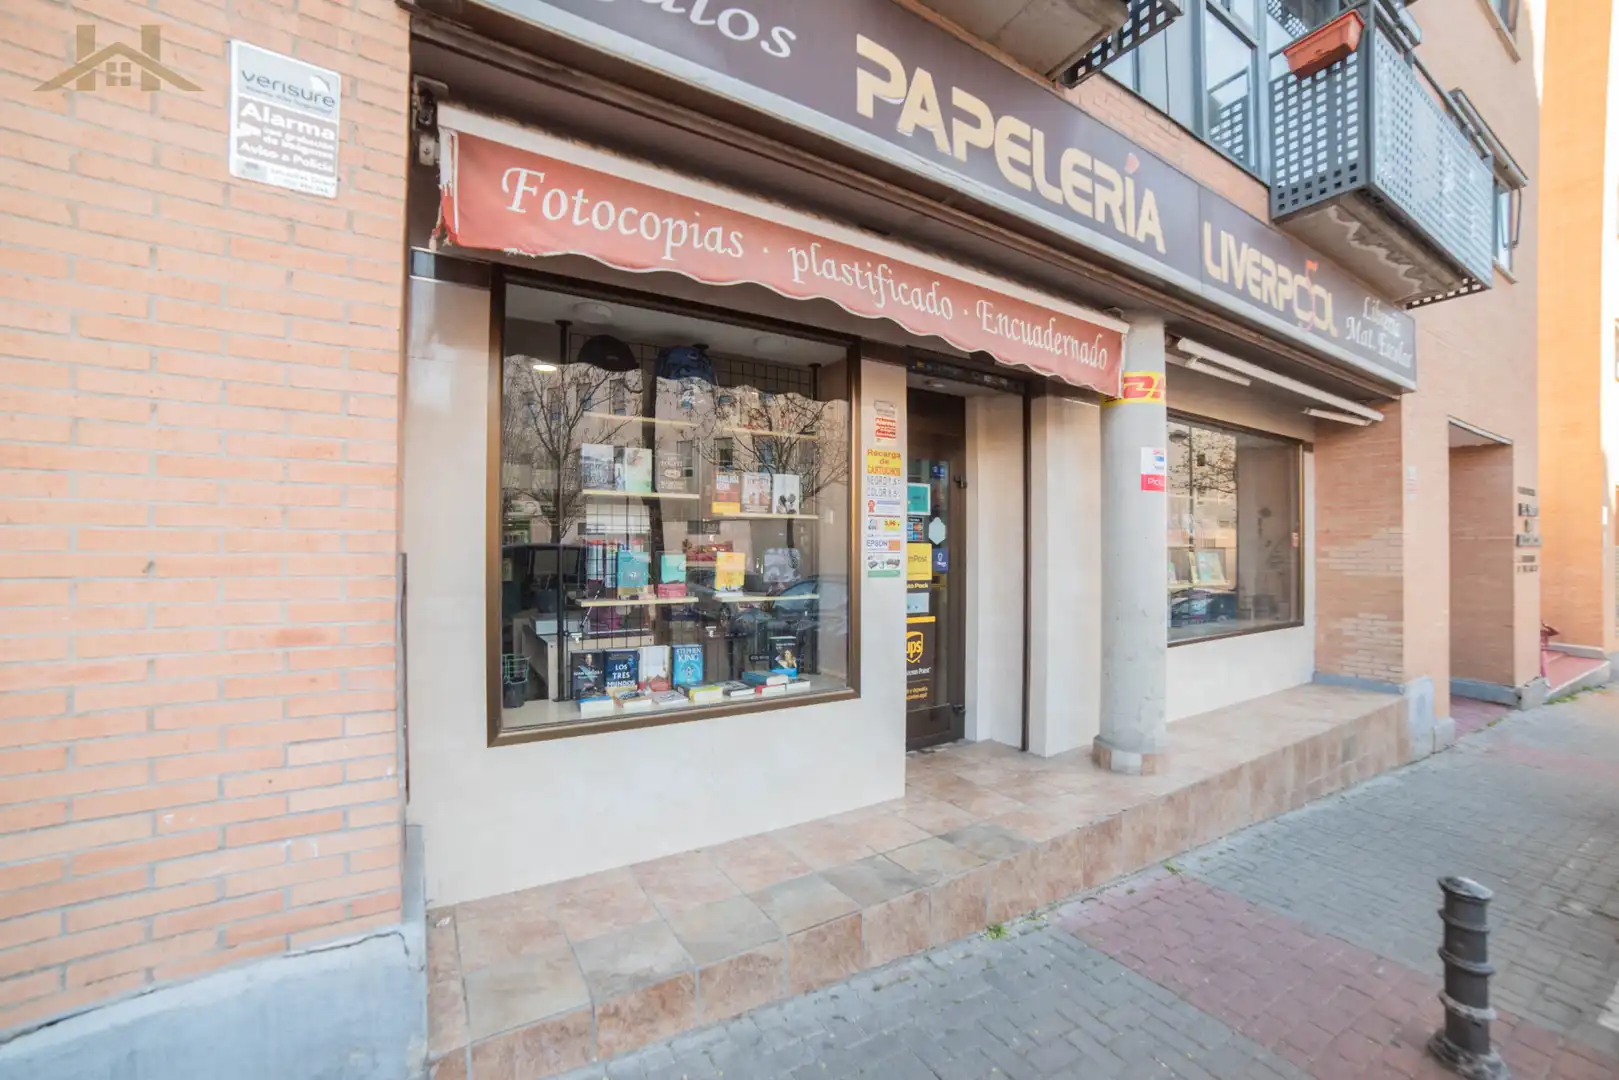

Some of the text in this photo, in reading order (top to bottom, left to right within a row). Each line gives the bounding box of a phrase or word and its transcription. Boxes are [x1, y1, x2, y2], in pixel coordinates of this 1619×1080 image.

[241, 70, 335, 108] verisure
[240, 102, 335, 140] Alarma
[240, 141, 279, 159] Aviso
[856, 33, 1166, 254] PAPELERÍA
[502, 167, 1107, 371] Fotocopias plastificado Encuadernado
[867, 449, 901, 459] Recarga
[866, 539, 887, 547] EPSON
[915, 581, 928, 589] Pack
[678, 653, 699, 661] KING
